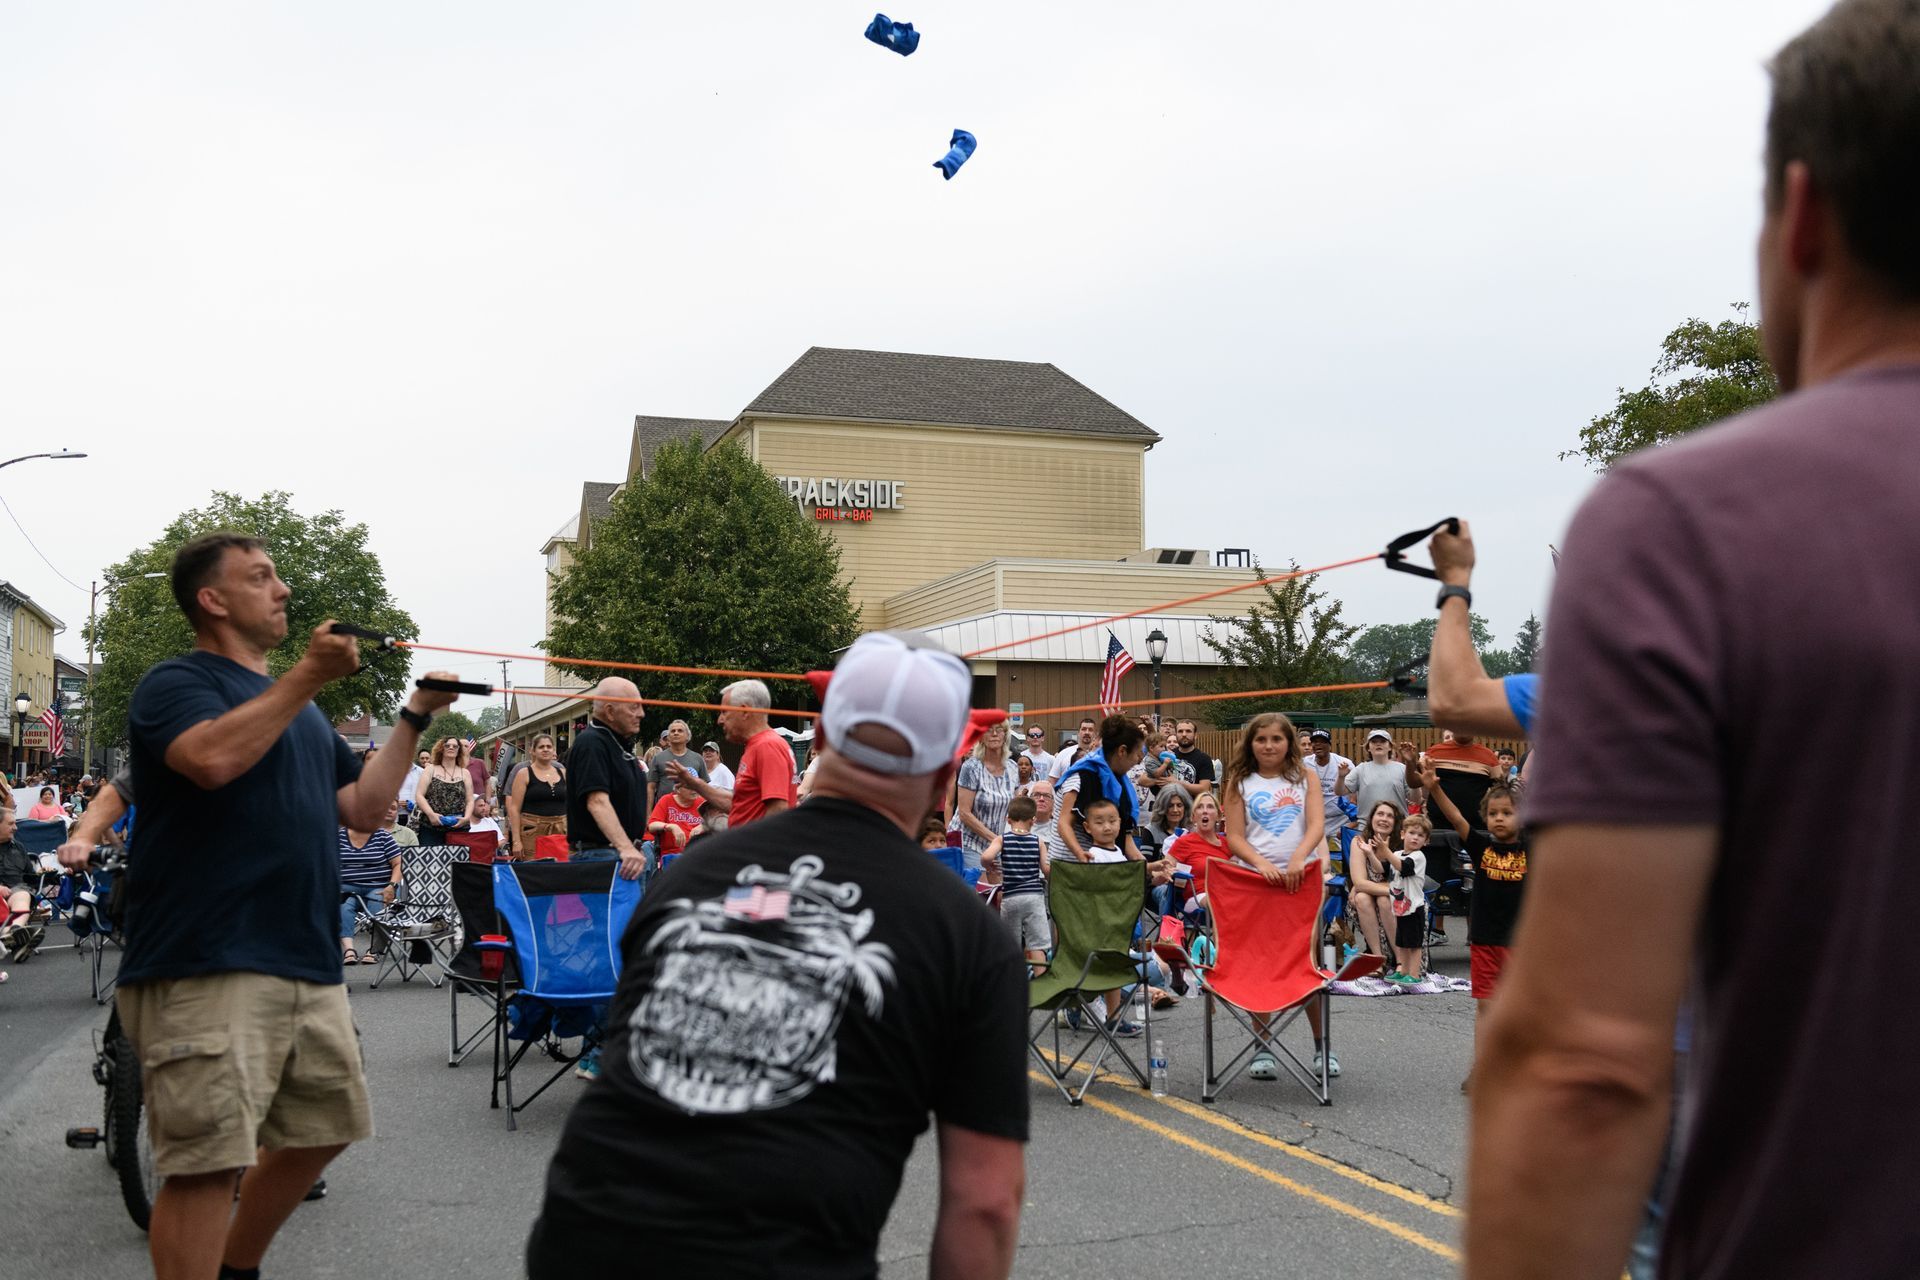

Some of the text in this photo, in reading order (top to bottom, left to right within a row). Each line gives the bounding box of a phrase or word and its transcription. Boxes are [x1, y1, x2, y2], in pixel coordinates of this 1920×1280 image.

[815, 507, 843, 521] GRILL
[852, 509, 873, 522] BAR
[23, 730, 49, 738] ARBER
[1486, 868, 1523, 881] THINGS
